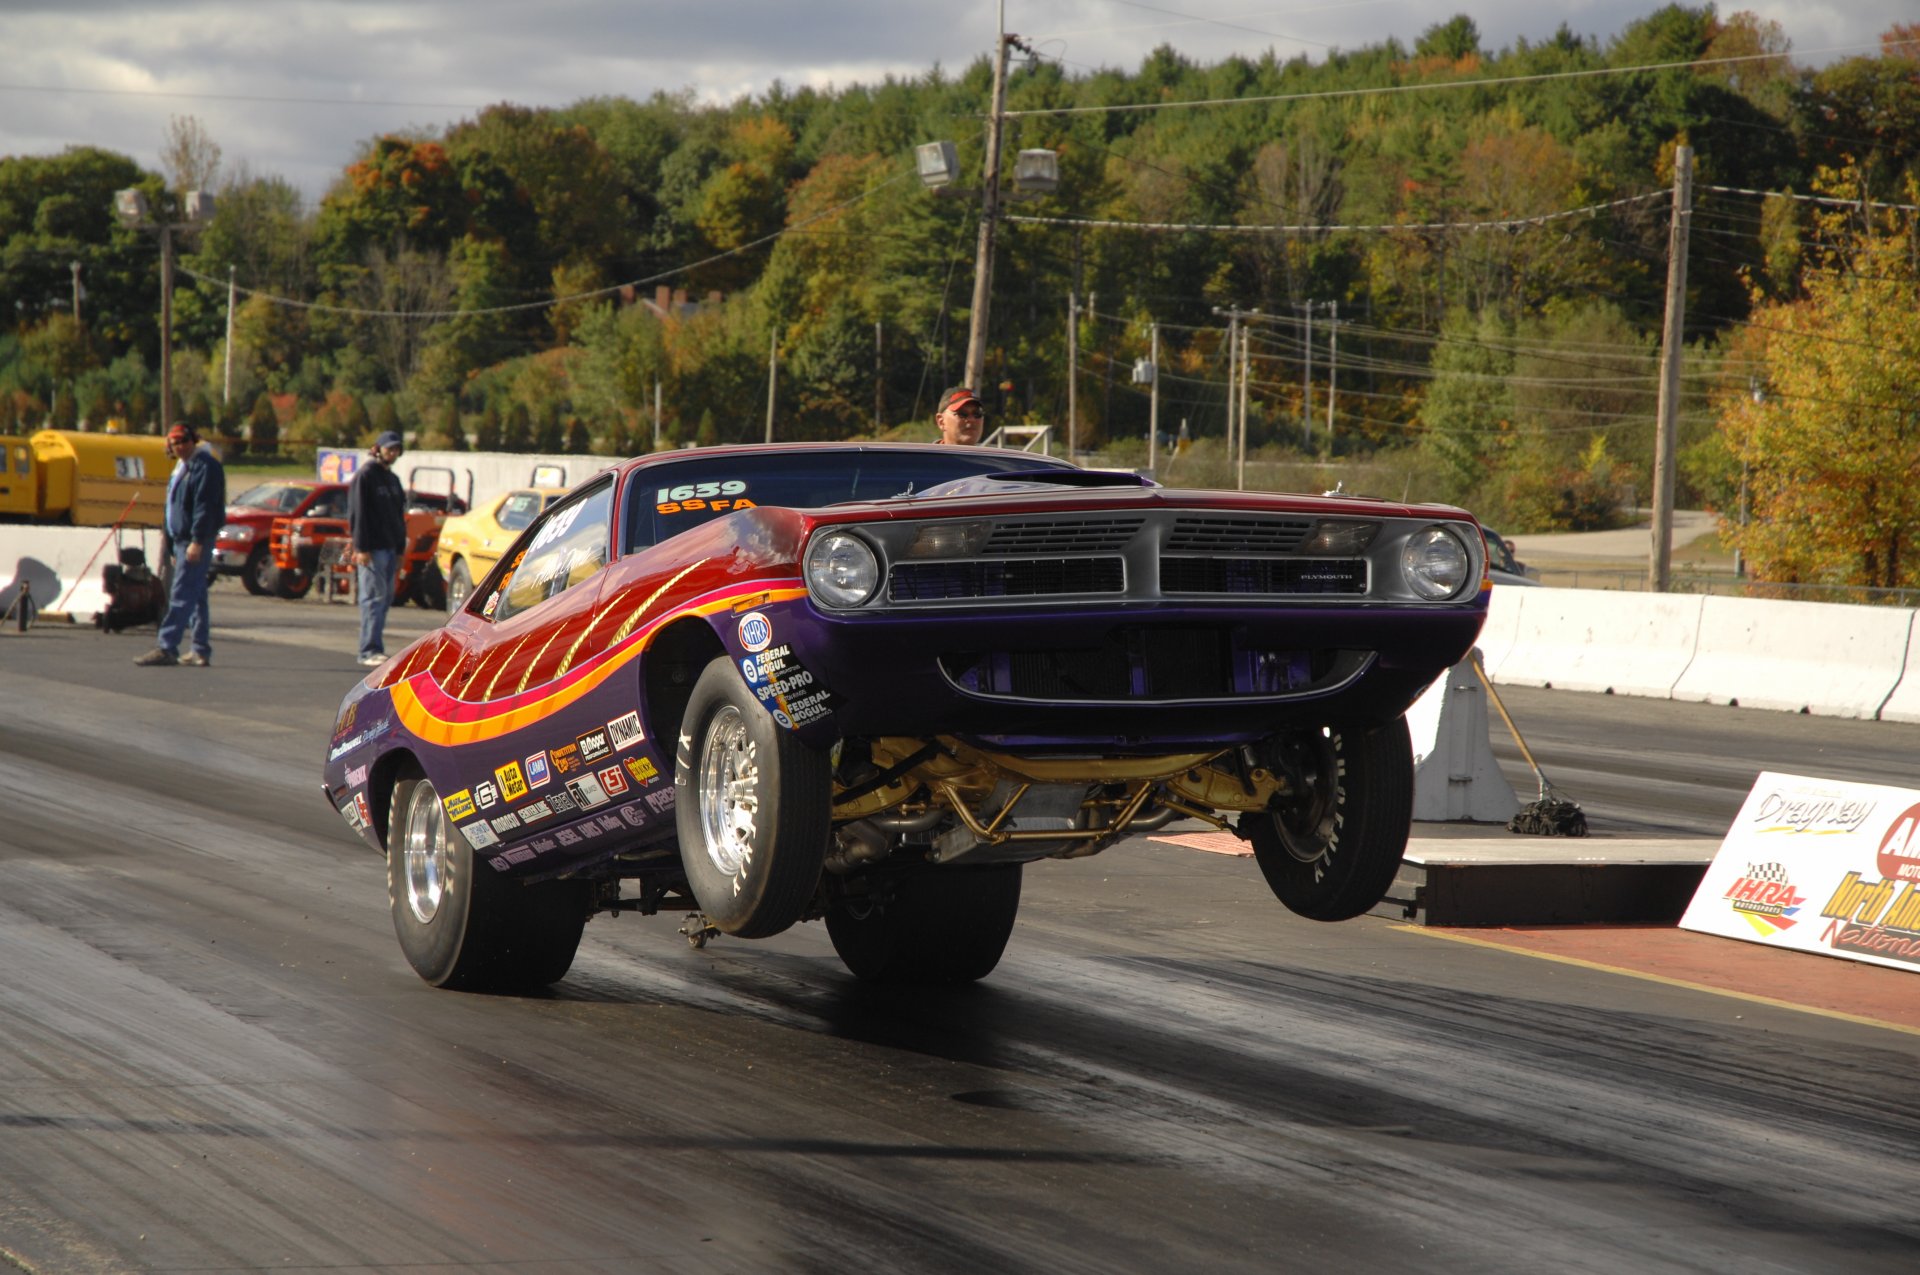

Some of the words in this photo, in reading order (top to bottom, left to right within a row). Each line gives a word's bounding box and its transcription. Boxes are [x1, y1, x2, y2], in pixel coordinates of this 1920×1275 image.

[657, 480, 746, 504] 1639
[743, 620, 767, 644] NHRA
[756, 644, 790, 665] FEDERAL
[757, 658, 786, 676] MOGUL
[787, 690, 831, 713] FEDERAL
[791, 703, 827, 722] MOGUL
[610, 715, 641, 744] DYNAMIC
[503, 767, 518, 782] Auto
[506, 779, 523, 796] Meter
[1754, 793, 1877, 832] Dragway
[1725, 877, 1797, 907] IHRA
[1820, 871, 1896, 925] North
[1735, 901, 1781, 914] MOTORSPORTS
